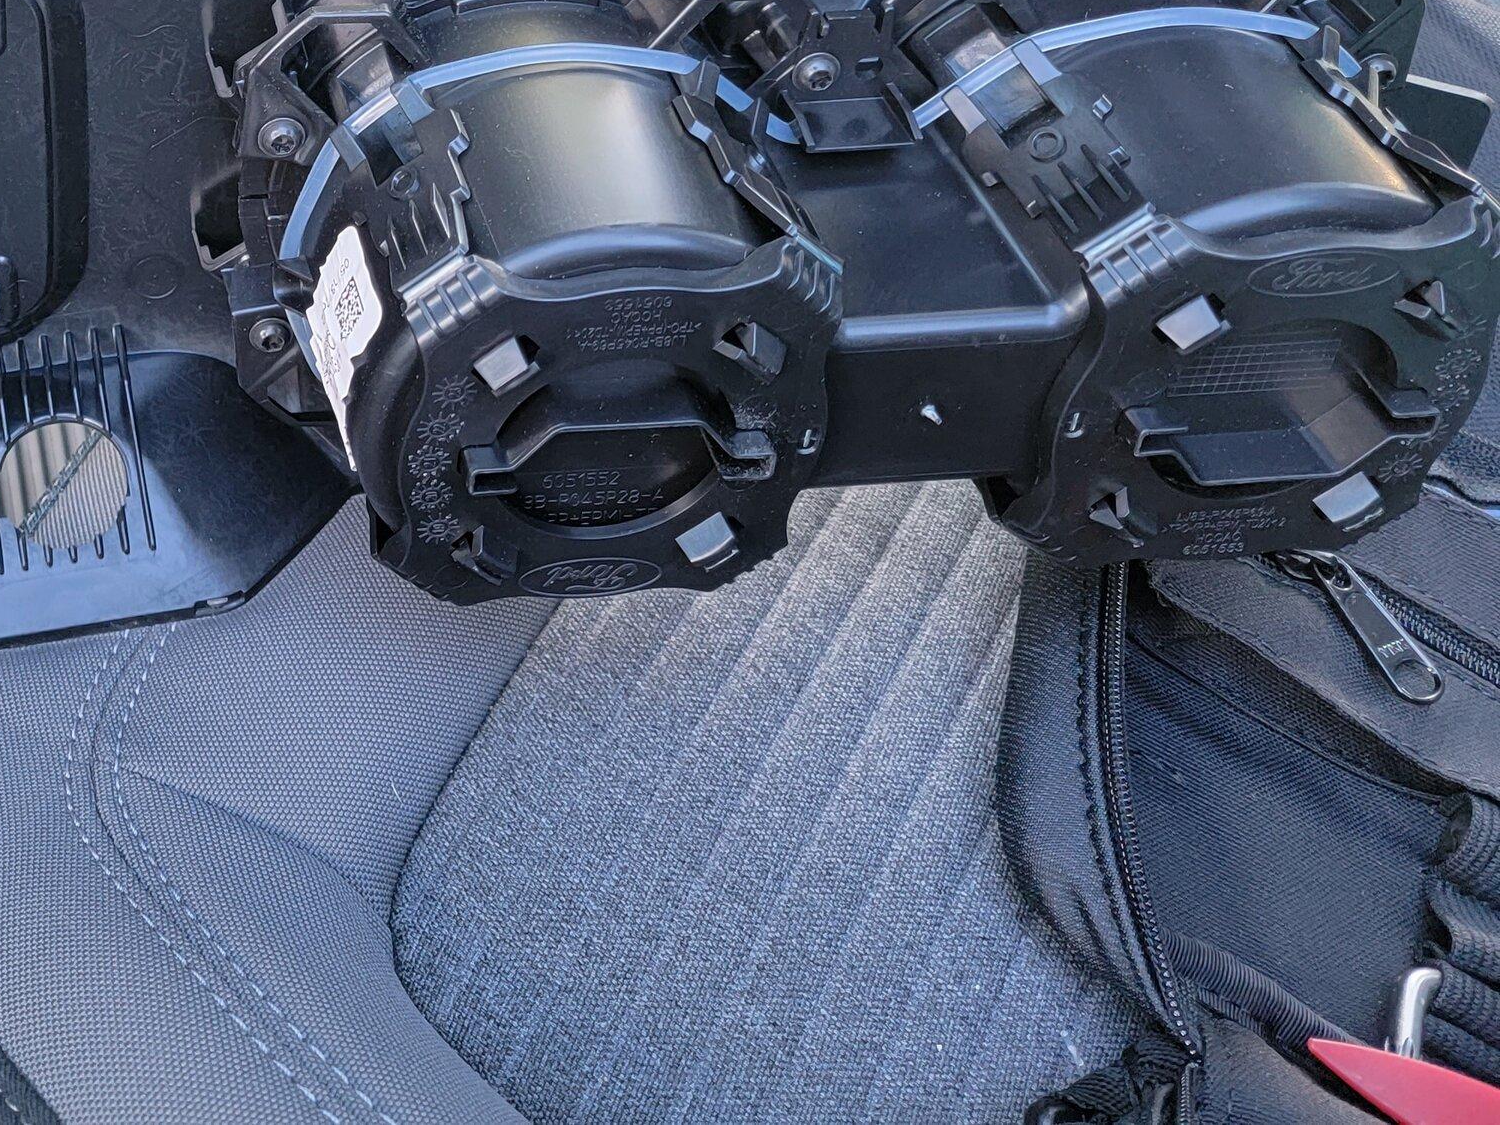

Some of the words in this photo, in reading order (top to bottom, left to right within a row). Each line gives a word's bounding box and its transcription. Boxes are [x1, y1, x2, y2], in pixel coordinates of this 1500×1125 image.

[1269, 256, 1380, 292] Ford
[542, 470, 621, 490] 6051552
[540, 561, 641, 593] Ford
